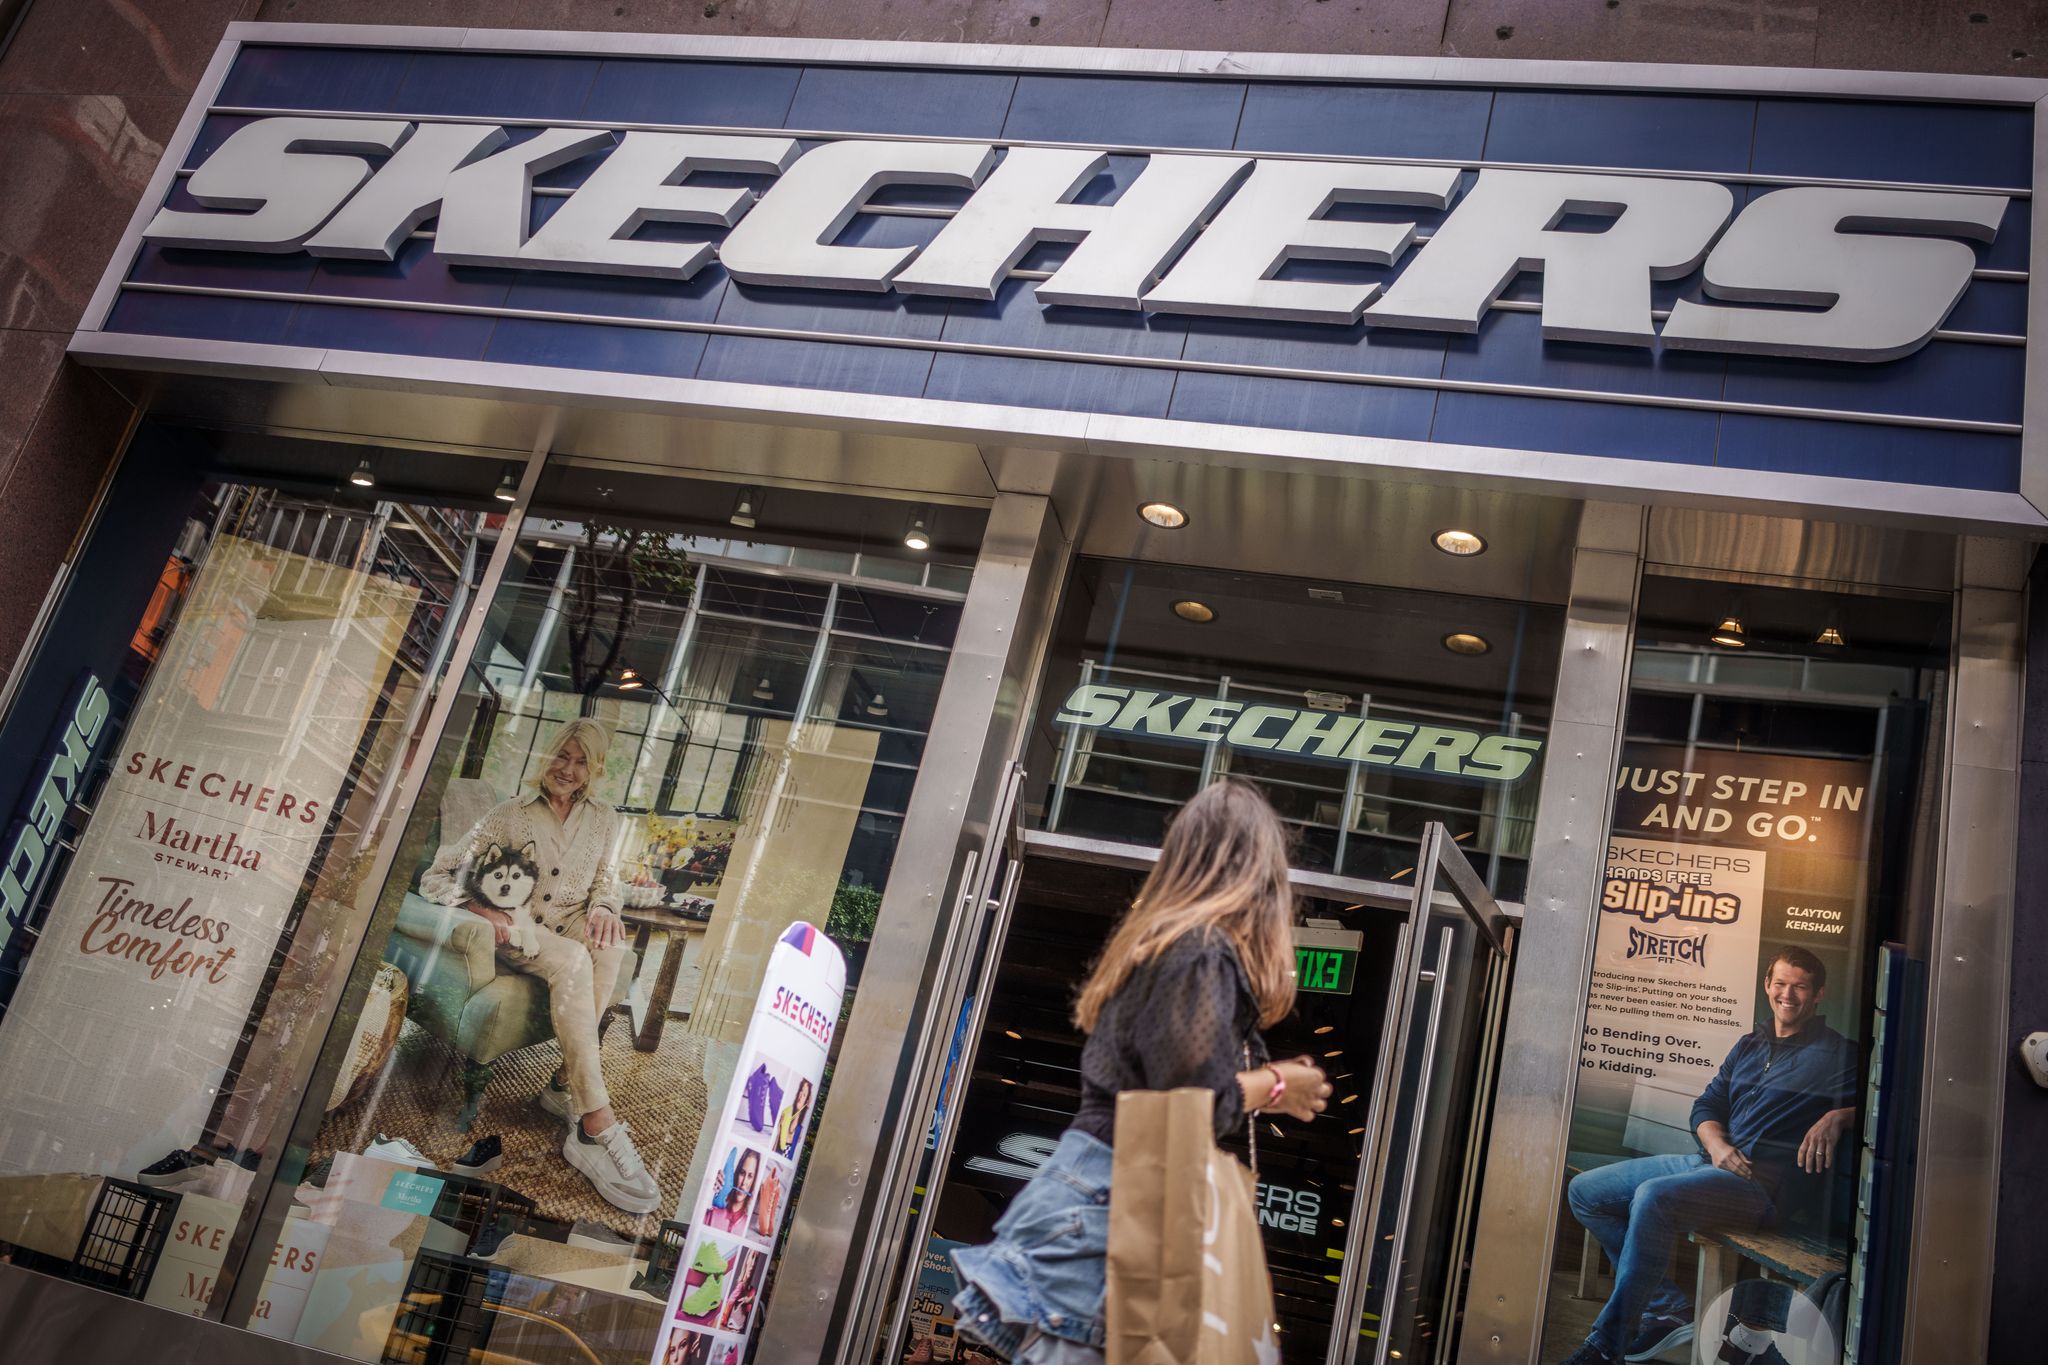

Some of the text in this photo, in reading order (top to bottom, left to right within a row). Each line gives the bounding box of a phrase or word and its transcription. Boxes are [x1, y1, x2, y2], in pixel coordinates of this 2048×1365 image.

[142, 116, 2010, 362] SKECHERS
[1056, 684, 1541, 781] SKECHERS
[127, 752, 319, 823] SKECHERS
[1616, 767, 1864, 811] JUST STEP IN
[1641, 803, 1733, 833] AND
[136, 811, 262, 871] Martha
[154, 852, 232, 881] STEWART
[1608, 846, 1750, 873] SKECHERS
[1666, 870, 1712, 886] FREE
[97, 877, 230, 944] Timeless
[1601, 878, 1739, 923] Slip-ins
[1787, 906, 1841, 921] CLAYTON
[1785, 920, 1844, 934] KERSHAW
[81, 911, 236, 984] Comfort
[1626, 926, 1708, 968] STRETCH
[1638, 976, 1655, 984] new
[1658, 978, 1696, 989] Skechers
[1699, 983, 1727, 992] Hands
[1642, 986, 1673, 998] Putting
[1690, 994, 1709, 1002] your
[1712, 996, 1737, 1005] shoes
[773, 986, 832, 1043] SKECHERS
[1600, 994, 1624, 1002] never
[1626, 996, 1648, 1005] been
[1650, 1000, 1678, 1009] easier.
[1681, 1003, 1693, 1011] No
[1696, 1005, 1732, 1016] bending
[1605, 1004, 1617, 1012] No
[1620, 1007, 1649, 1017] pulling
[1652, 1011, 1674, 1019] them
[1708, 1018, 1742, 1028] hassles.
[1603, 1028, 1660, 1046] Bending
[1665, 1035, 1701, 1049] Over.
[1599, 1060, 1656, 1078] Kidding.
[1601, 1044, 1664, 1063] Touching
[1669, 1053, 1714, 1068] Shoes.
